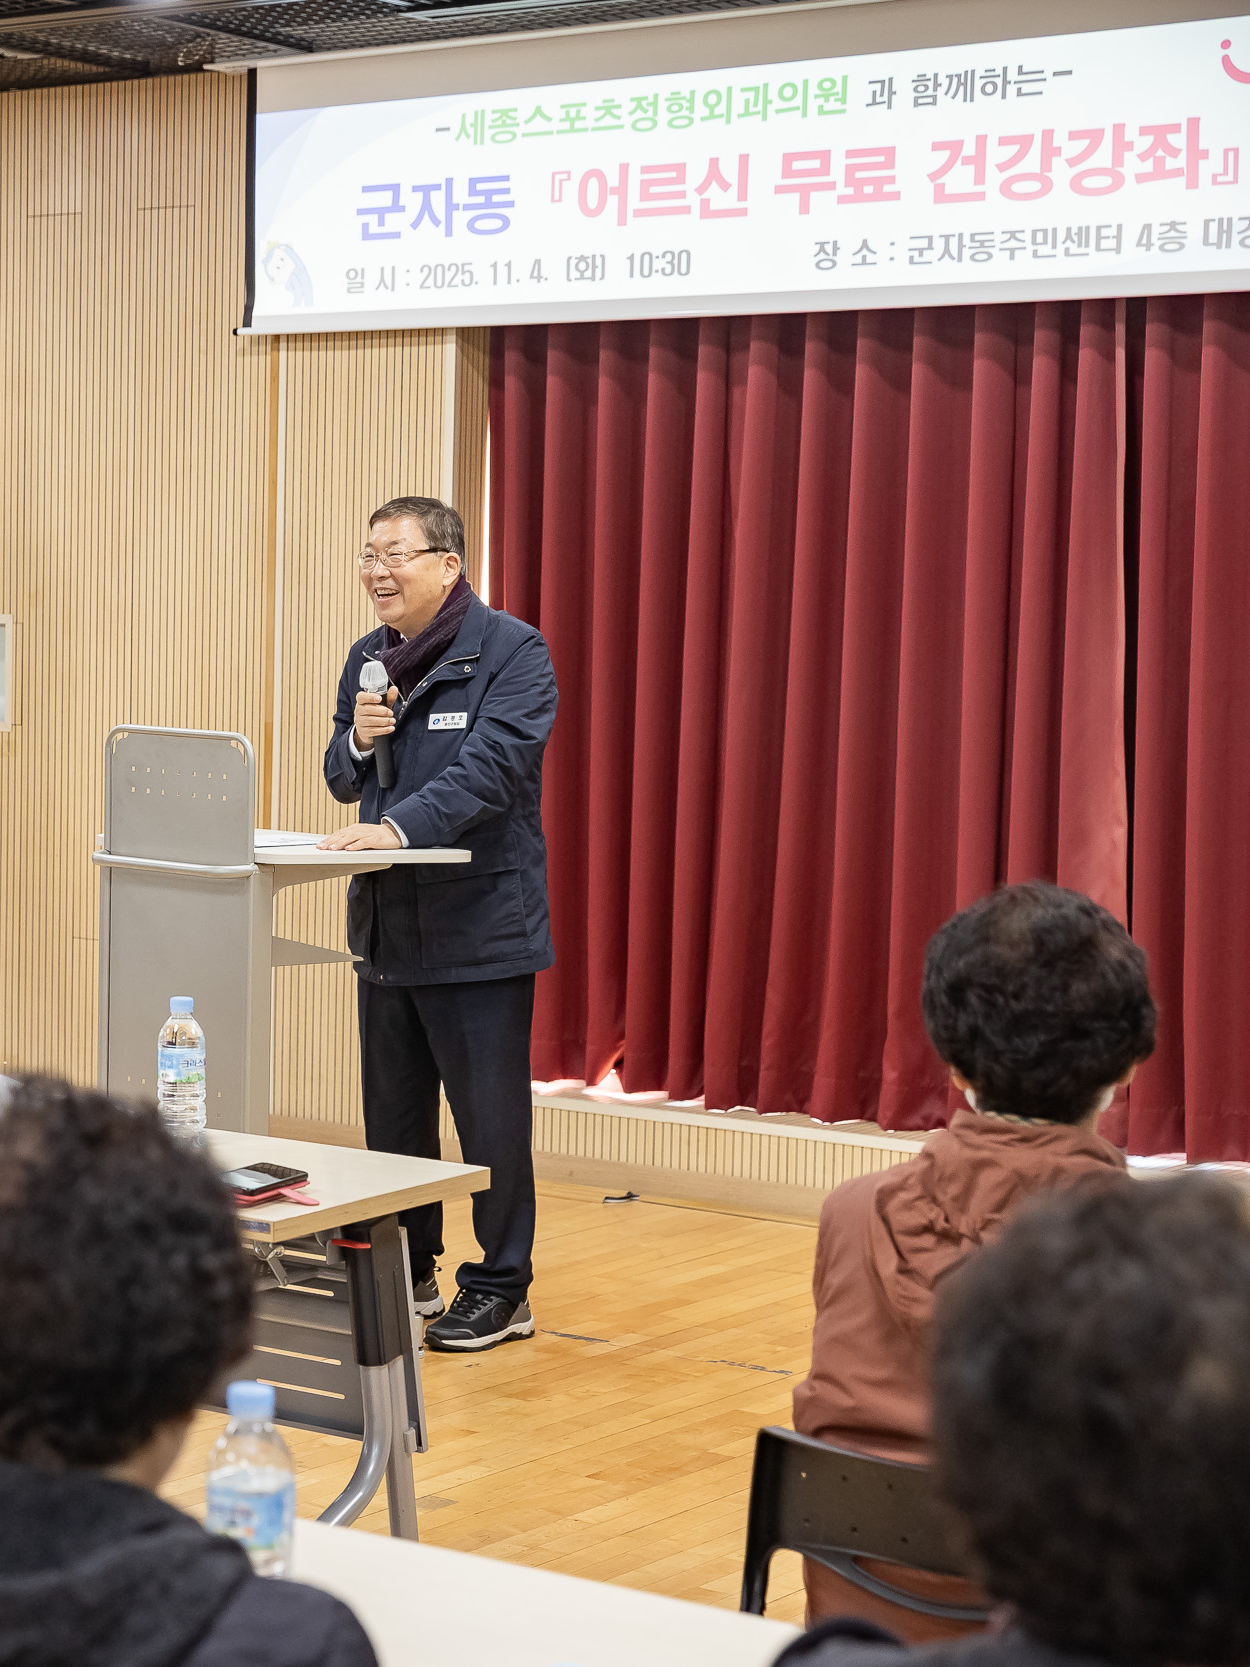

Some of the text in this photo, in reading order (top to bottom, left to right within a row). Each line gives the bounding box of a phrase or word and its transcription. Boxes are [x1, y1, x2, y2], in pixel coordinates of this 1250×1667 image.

[865, 76, 897, 110] 과
[911, 64, 1074, 108] 함께하는-
[356, 116, 1240, 241] 군자동 『어르신 무료 건강강좌』
[908, 223, 1123, 266] 군자동주민센터
[1136, 220, 1188, 254] 4층
[419, 261, 479, 290] 2025.
[490, 259, 521, 286] 11.
[529, 258, 549, 284] 4.
[566, 253, 606, 283] (화)
[626, 248, 692, 279] 10:30
